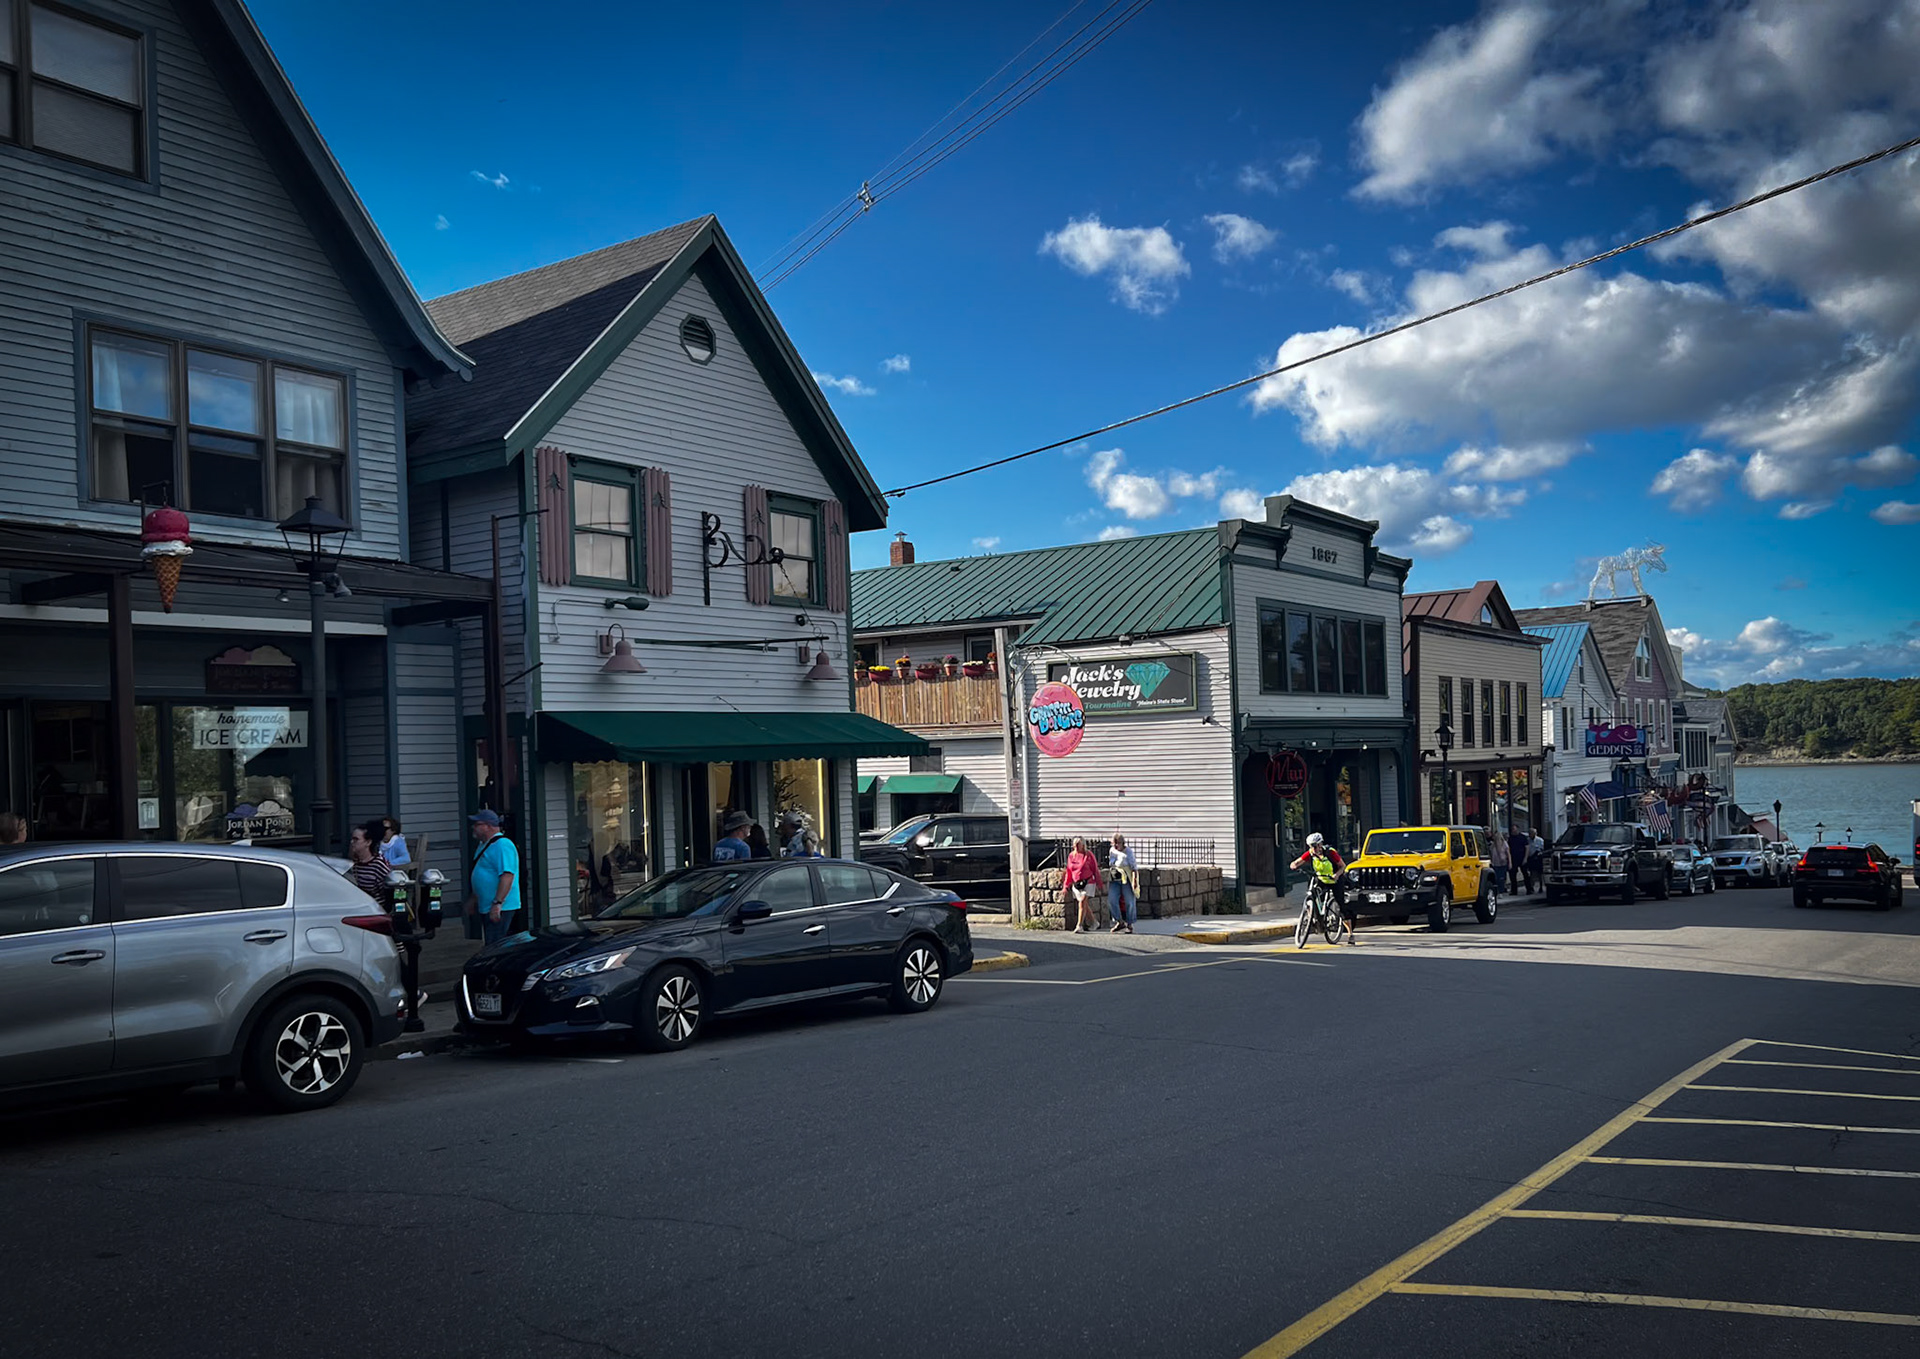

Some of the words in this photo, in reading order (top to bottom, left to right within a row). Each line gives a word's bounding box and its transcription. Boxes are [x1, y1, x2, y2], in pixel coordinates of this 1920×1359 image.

[1312, 546, 1338, 564] 1887
[1061, 664, 1124, 686] Jack's
[1029, 701, 1072, 725] GRAFFITI
[1084, 701, 1132, 710] Tourmaline
[217, 713, 285, 724] homemade
[1038, 708, 1085, 735] DONUTS
[200, 729, 229, 746] ICE
[237, 729, 301, 745] CREAM
[226, 820, 263, 832] JORDAN
[265, 818, 292, 830] POND
